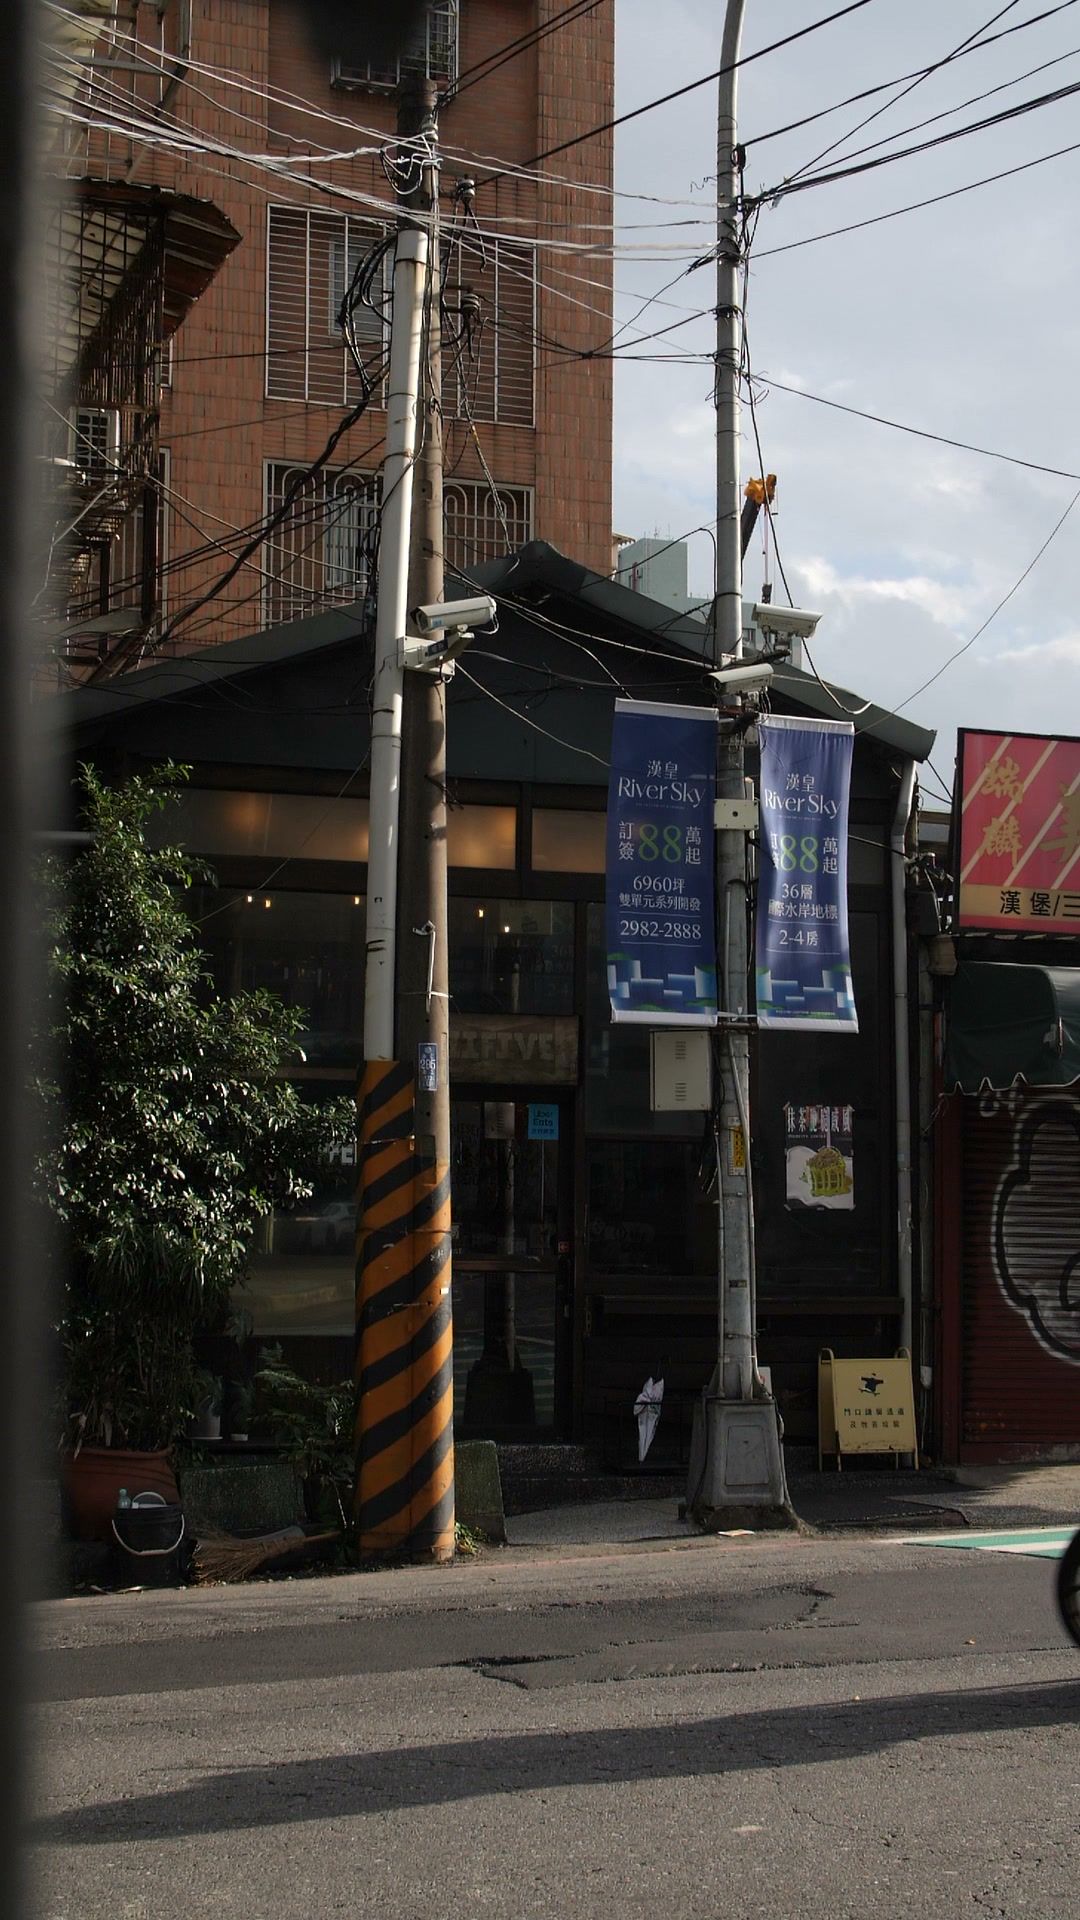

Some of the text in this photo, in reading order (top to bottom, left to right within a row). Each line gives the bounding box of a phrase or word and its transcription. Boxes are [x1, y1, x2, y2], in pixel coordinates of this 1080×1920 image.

[646, 760, 678, 781] 漢皇
[618, 776, 706, 808] River Sky
[785, 773, 815, 793] 漢皇
[764, 788, 842, 819] River Sky
[638, 823, 682, 862] 88
[685, 826, 702, 865] 萬起
[780, 835, 819, 873] 88
[823, 837, 839, 874] 萬起
[633, 875, 686, 894] 6960坪
[781, 883, 813, 900] 36層
[619, 892, 702, 911] 雙單元系列開發
[620, 920, 702, 940] 2982-2888
[779, 929, 819, 947] 2-4房
[533, 1118, 553, 1127] Eats
